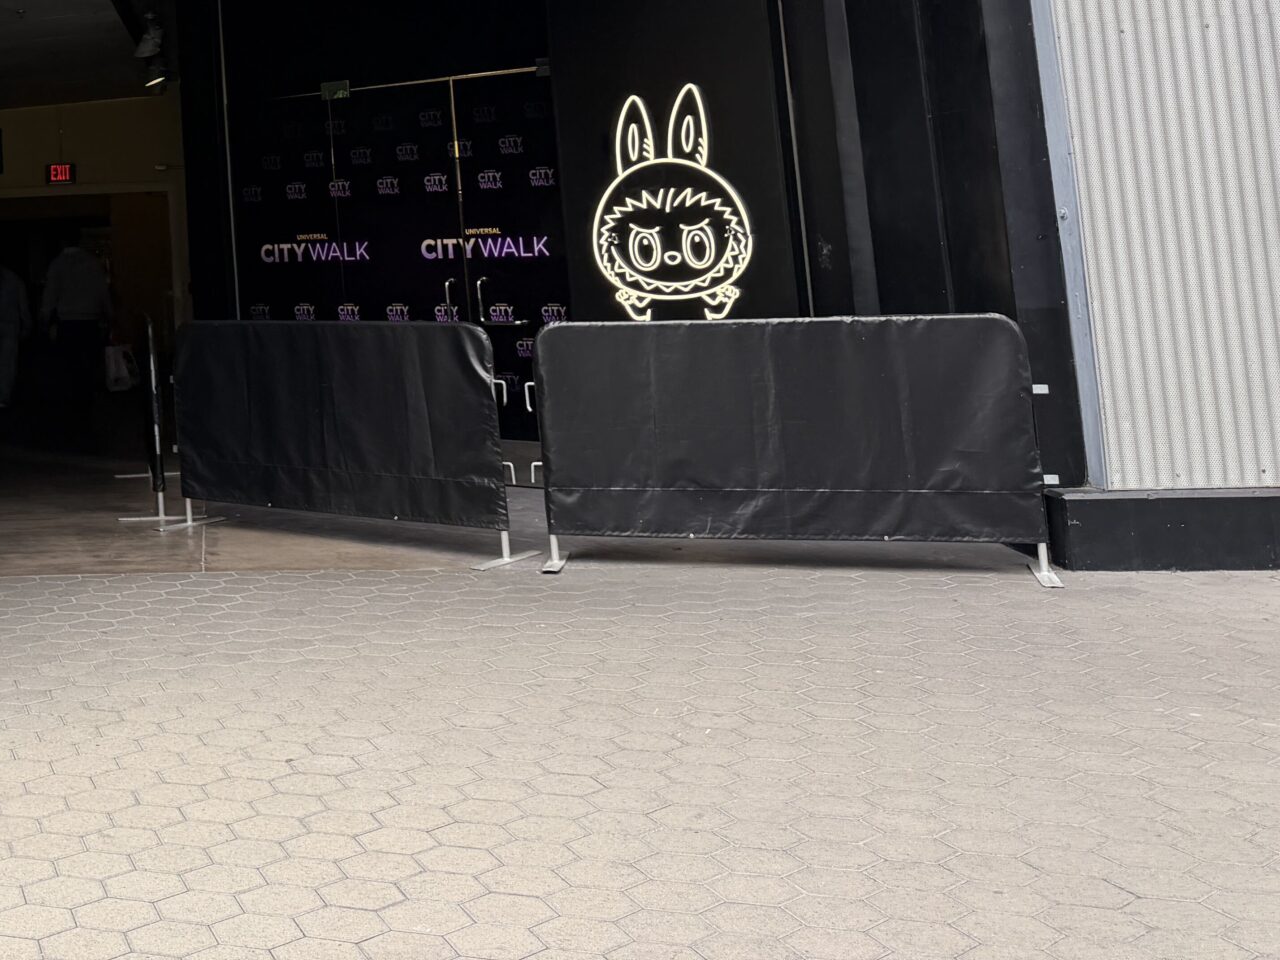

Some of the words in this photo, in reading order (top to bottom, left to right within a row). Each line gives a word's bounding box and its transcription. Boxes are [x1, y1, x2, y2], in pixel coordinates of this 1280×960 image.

[498, 137, 523, 146] CITY
[396, 144, 418, 154] CITY
[50, 165, 70, 181] EXIT
[477, 172, 502, 182] CITY
[529, 169, 554, 179] CITY
[377, 178, 398, 187] CITY
[424, 174, 447, 184] CITY
[530, 178, 555, 187] WALK
[286, 184, 306, 192] CITY
[329, 181, 350, 190] CITY
[425, 184, 448, 192] WALK
[479, 181, 503, 189] WALK
[465, 227, 501, 235] UNIVERSAL
[294, 305, 315, 314] CITY
[338, 305, 359, 314] CITY
[386, 305, 408, 315] CITY
[490, 305, 513, 315] CITY
[541, 306, 566, 316] CITY
[516, 340, 533, 350] CIT
